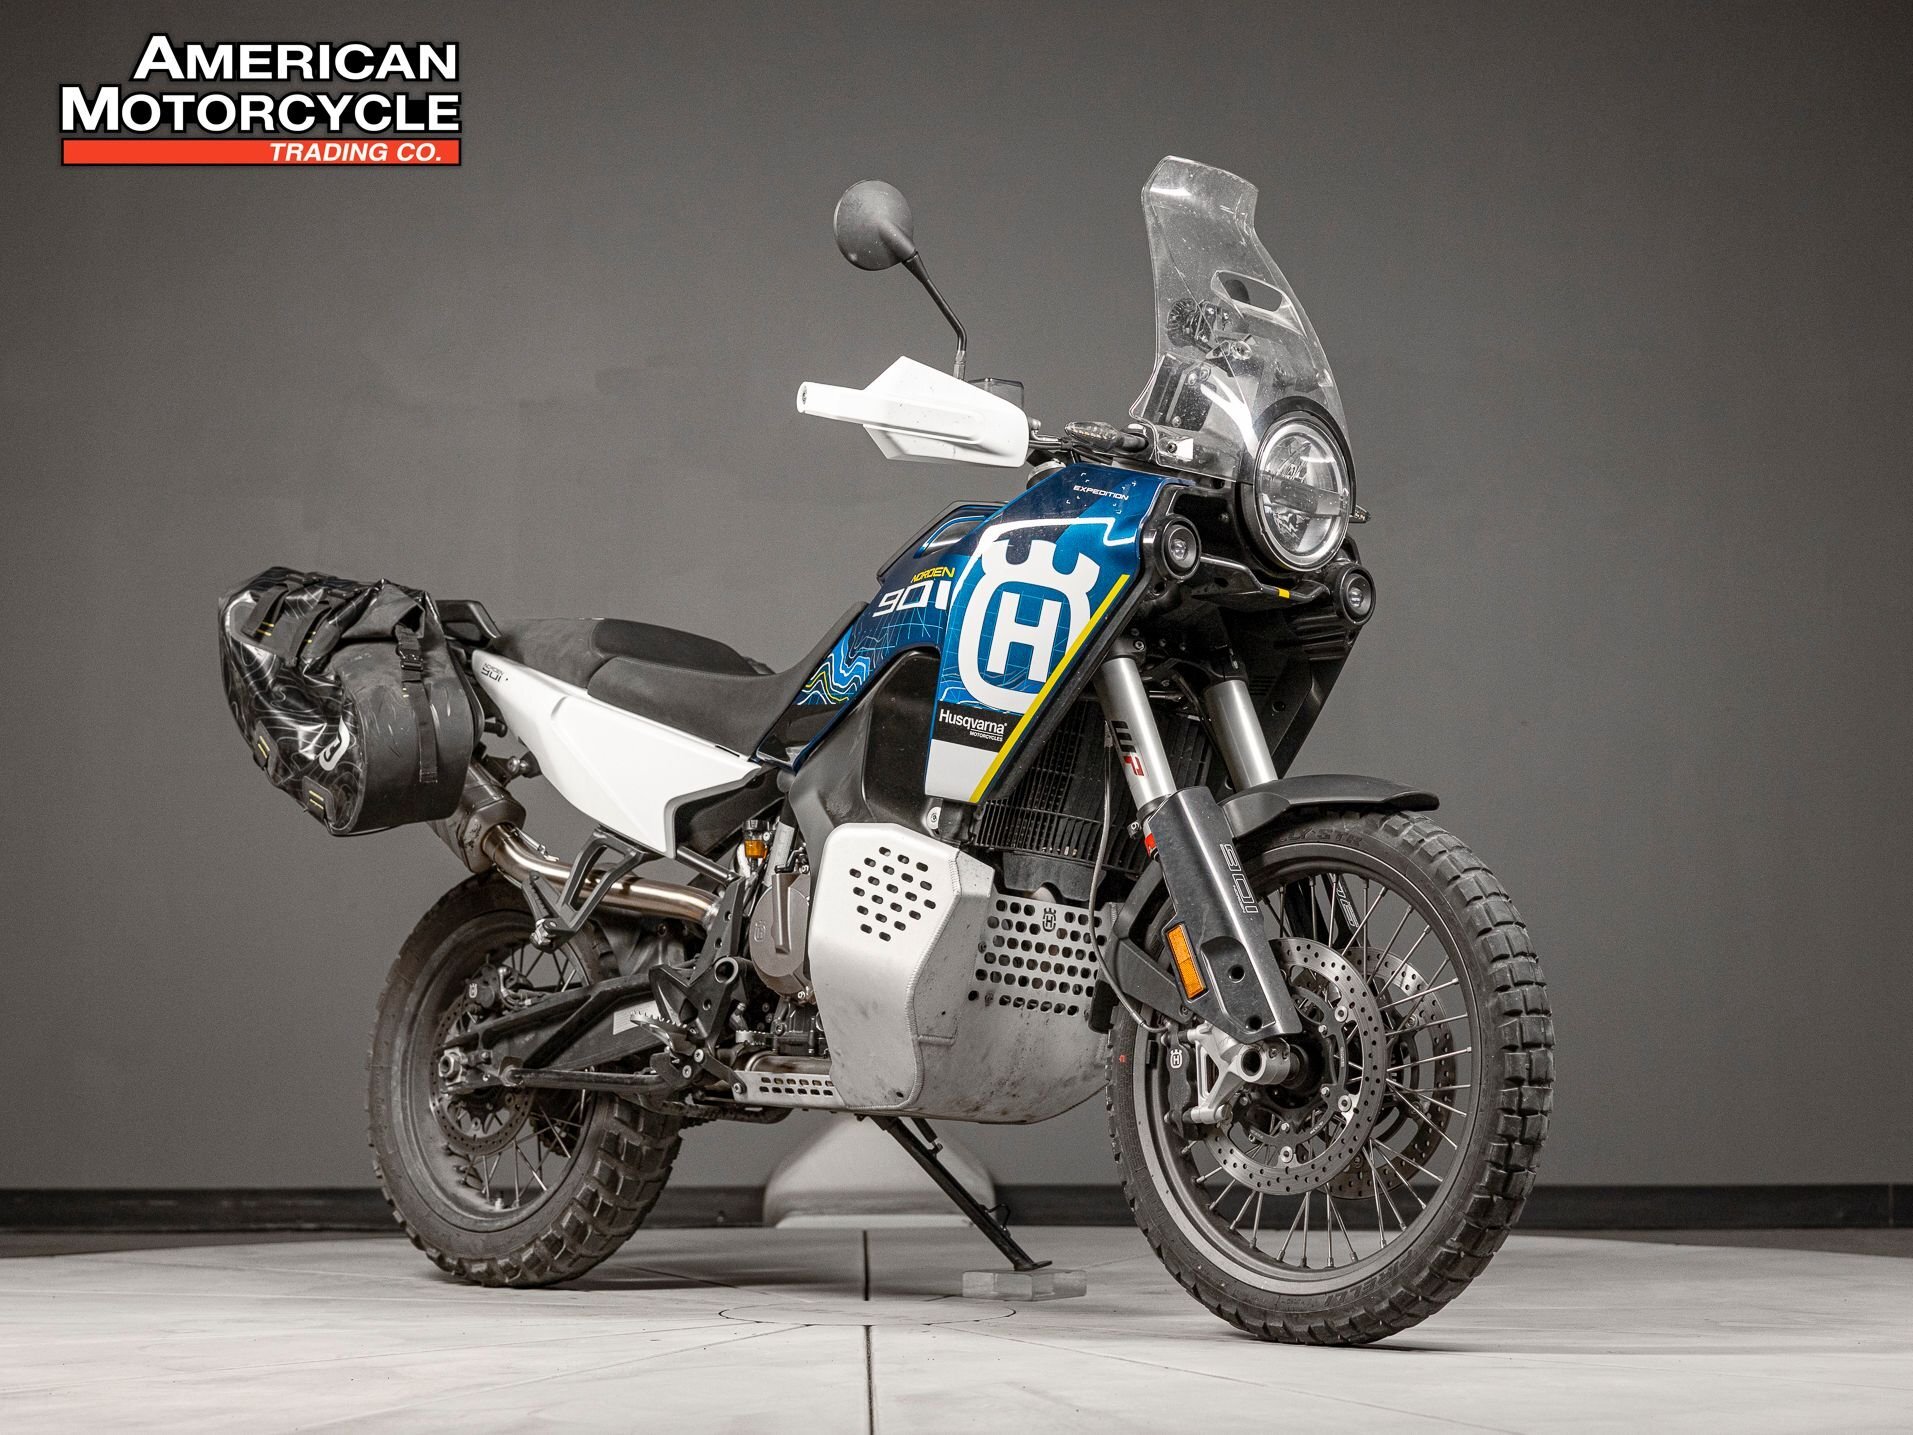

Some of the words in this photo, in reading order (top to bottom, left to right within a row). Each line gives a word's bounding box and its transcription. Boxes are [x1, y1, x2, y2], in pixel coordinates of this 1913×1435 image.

[1073, 485, 1129, 500] EXPEDITION
[910, 566, 955, 583] NORDEN
[872, 580, 951, 617] 901
[939, 709, 1006, 735] Husqvarna
[969, 731, 1003, 742] MOTORCYCLES
